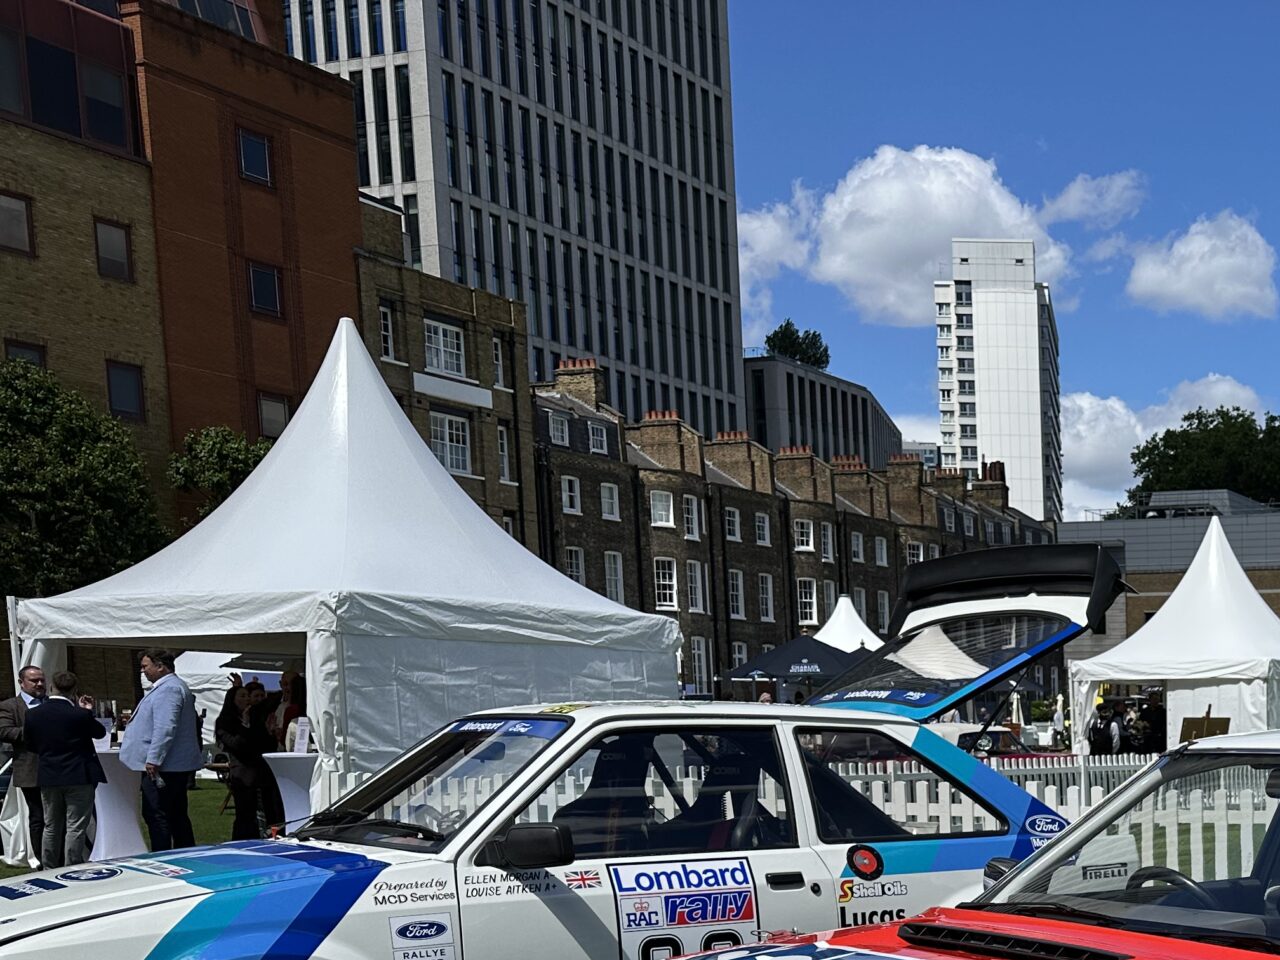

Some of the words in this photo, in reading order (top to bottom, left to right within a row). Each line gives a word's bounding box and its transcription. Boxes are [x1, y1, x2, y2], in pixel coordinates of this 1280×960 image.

[1035, 818, 1060, 832] Ford
[464, 874, 497, 885] ELLEN
[500, 872, 541, 883] MORGAN
[612, 861, 750, 892] Lombard
[1082, 862, 1128, 880] PIRELLI
[373, 880, 433, 897] Prepared
[434, 879, 448, 891] by
[466, 885, 501, 898] LOUISE
[506, 884, 541, 895] AITKEN
[852, 882, 881, 898] Shell
[882, 881, 908, 896] Oils
[374, 894, 408, 906] MCD
[410, 892, 456, 903] Services
[626, 911, 659, 927] RAC
[667, 892, 750, 925] rally
[840, 906, 906, 928] Lucas
[406, 923, 437, 938] Ford
[403, 948, 446, 960] RALLYE
